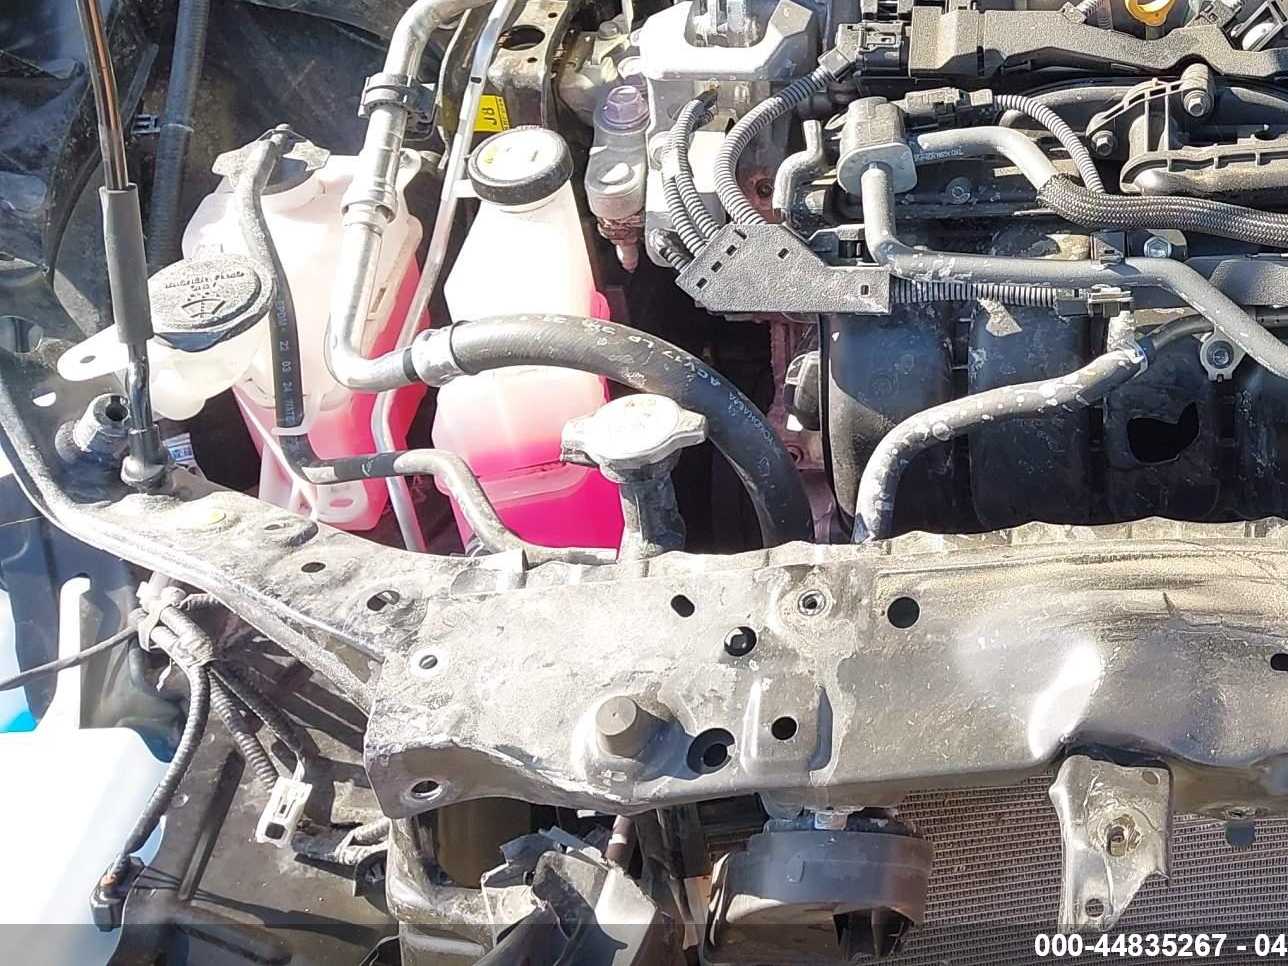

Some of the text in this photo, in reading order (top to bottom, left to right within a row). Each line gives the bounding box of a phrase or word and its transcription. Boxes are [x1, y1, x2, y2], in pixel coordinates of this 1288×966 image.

[481, 107, 498, 126] J8
[280, 340, 289, 351] 22
[283, 399, 296, 426] WATE
